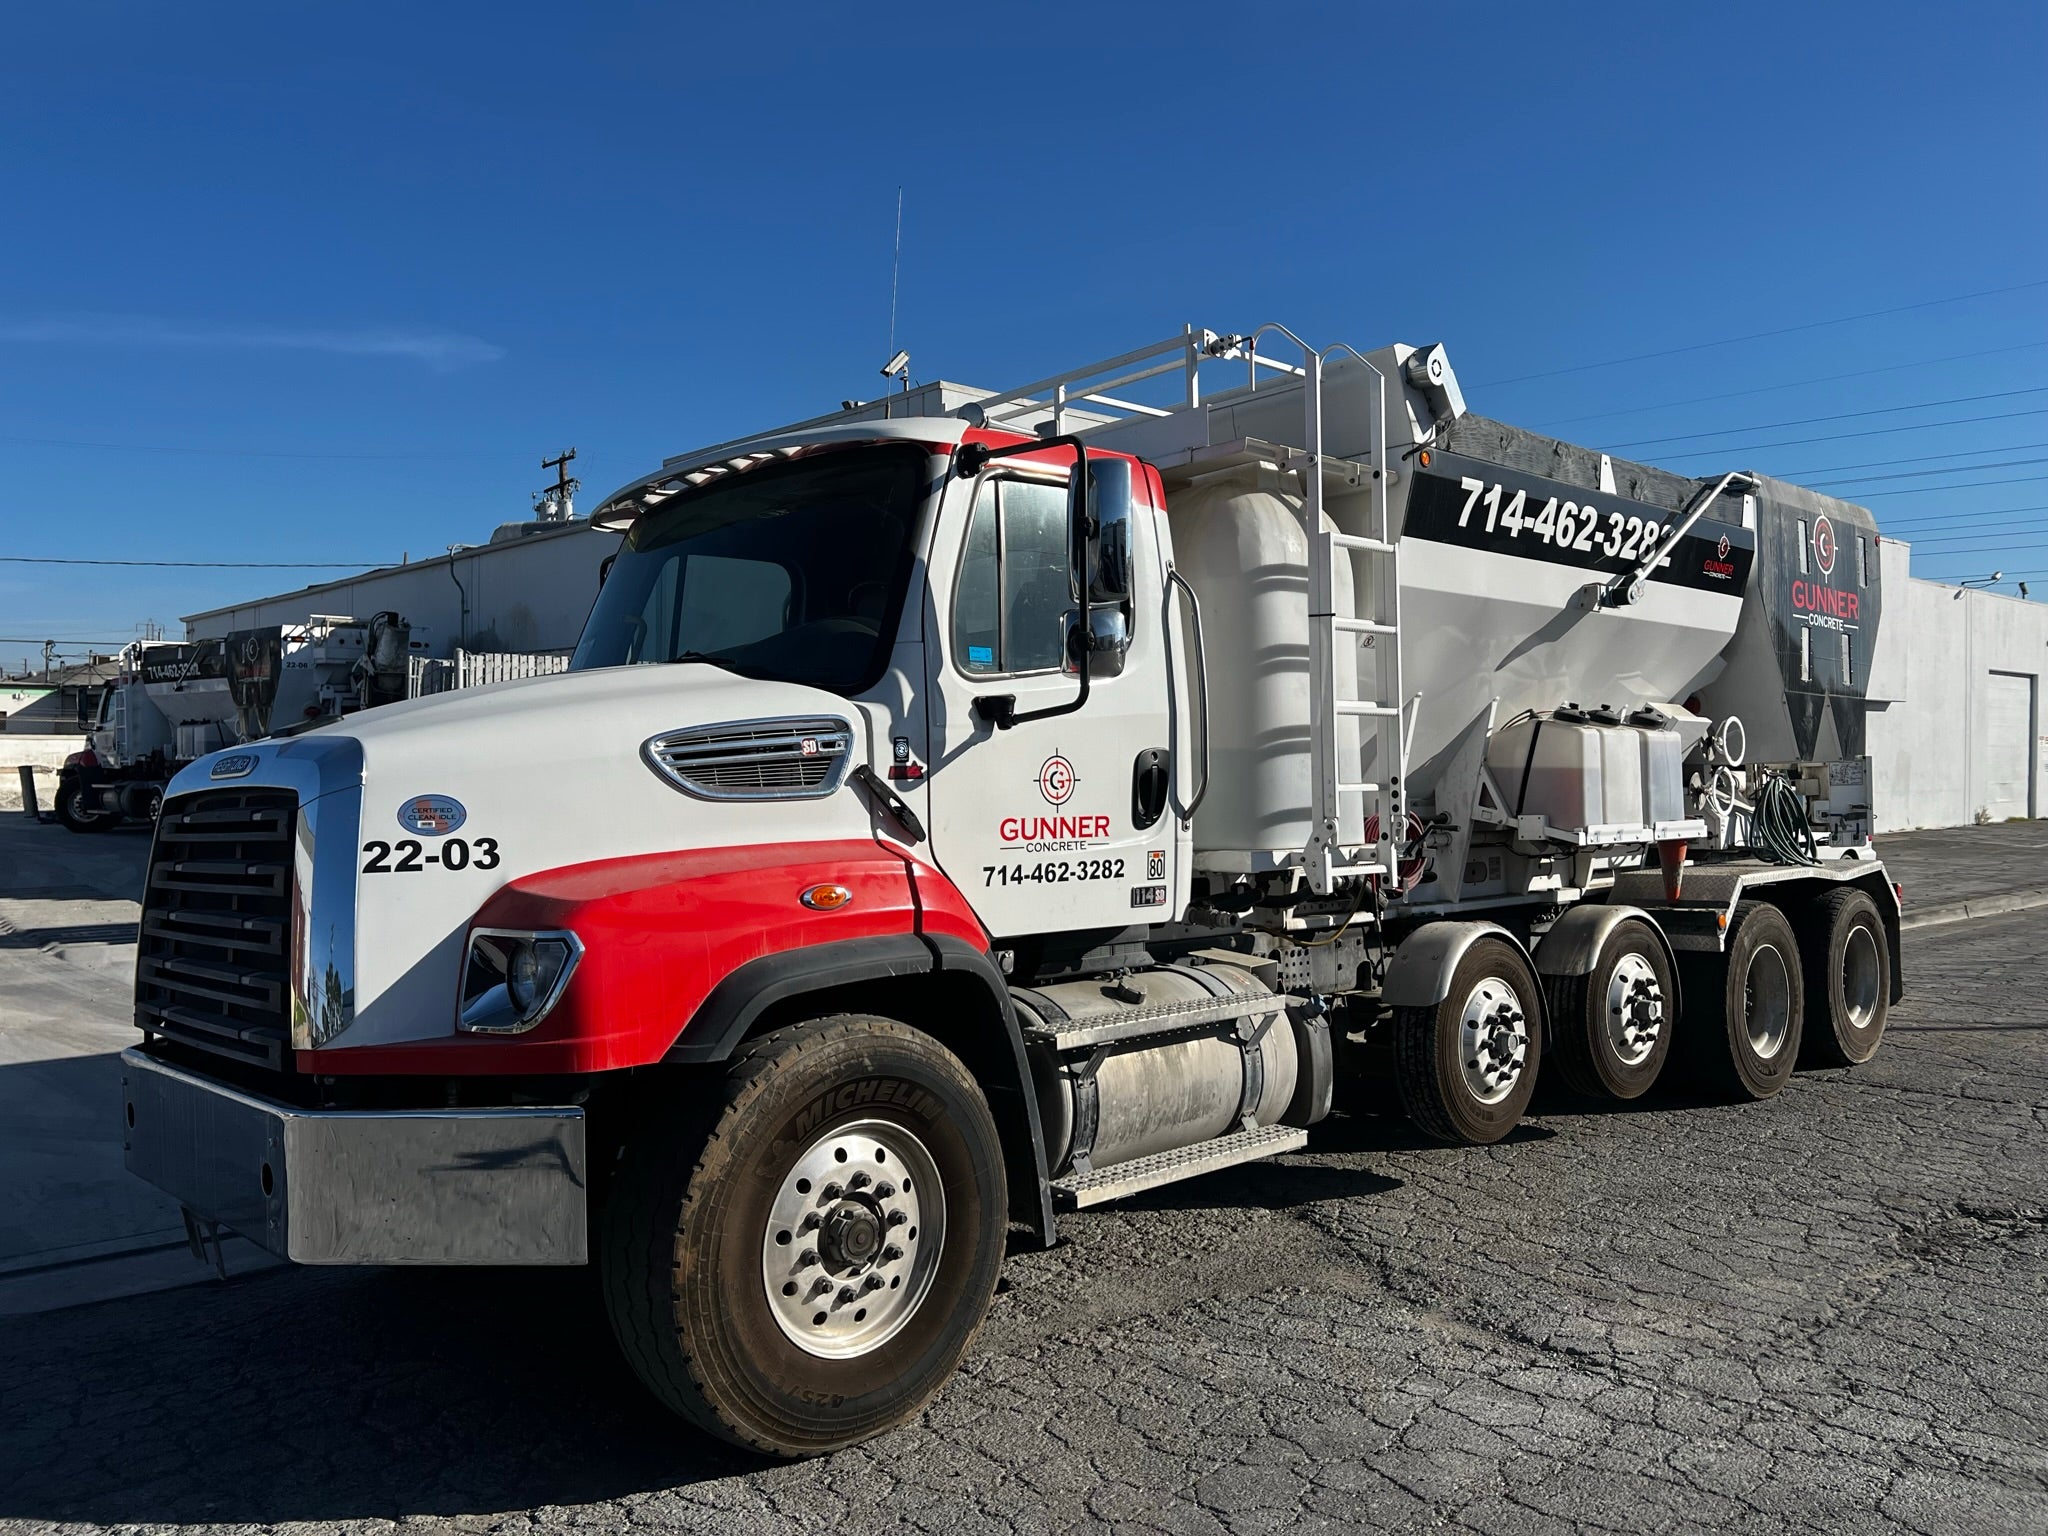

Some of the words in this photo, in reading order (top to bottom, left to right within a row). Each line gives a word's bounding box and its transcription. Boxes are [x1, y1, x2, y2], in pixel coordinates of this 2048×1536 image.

[1792, 580, 1859, 620] GUNNER
[1808, 613, 1844, 631] CONCRETE
[803, 740, 817, 753] SD
[1000, 816, 1110, 841] GUNNER
[362, 837, 501, 874] 22-03
[1026, 841, 1087, 853] CONCRETE
[983, 858, 1125, 887] 714-462-3282
[1149, 858, 1163, 877] 80
[796, 1079, 945, 1142] MICHELIN
